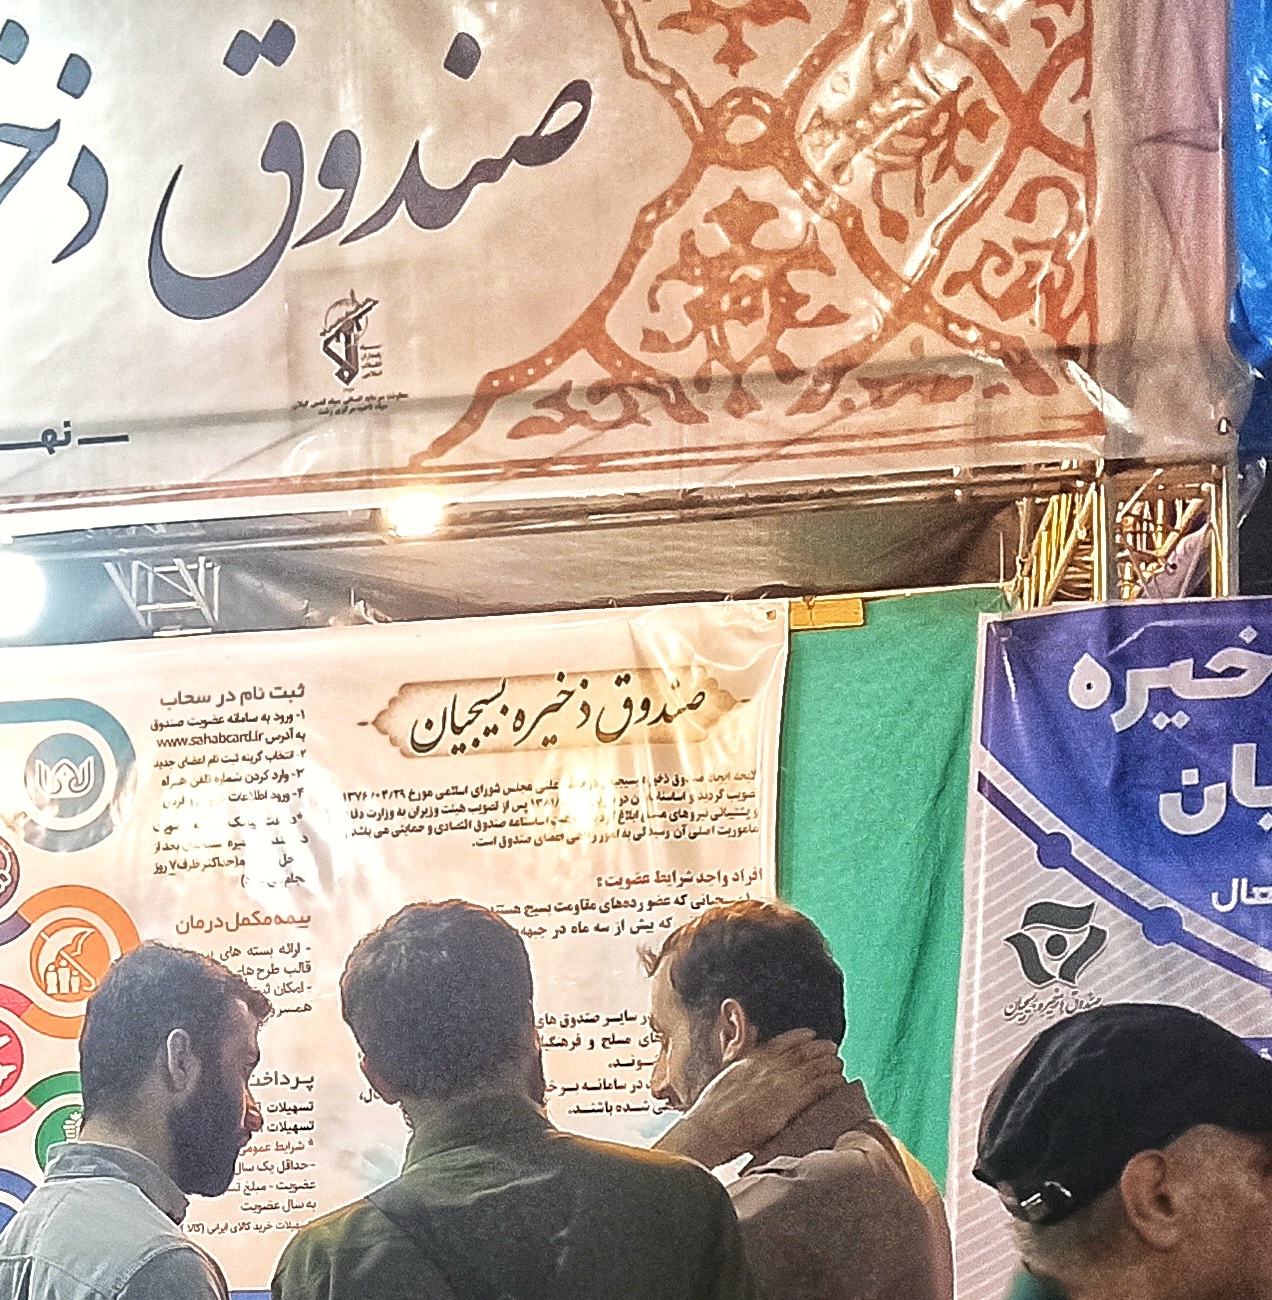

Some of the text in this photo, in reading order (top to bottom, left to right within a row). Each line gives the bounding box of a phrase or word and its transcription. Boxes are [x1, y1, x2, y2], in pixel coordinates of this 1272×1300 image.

[146, 19, 592, 319] صندوق
[160, 683, 305, 711] ثبت نام در سحاب
[410, 671, 706, 756] صندوق ذخیره بسیجیان
[151, 712, 293, 731] ورود به سامانه عضویت صندوق
[265, 727, 294, 744] آدرس
[296, 732, 306, 742] به
[221, 754, 239, 765] ثبت
[242, 750, 263, 764] گزینه
[265, 750, 294, 763] انتخاب
[245, 770, 269, 784] کردن
[272, 769, 289, 782] وارد
[471, 783, 500, 798] شورای
[503, 782, 533, 796] مجلس
[367, 809, 394, 821] وزارت
[397, 808, 406, 818] به
[408, 806, 438, 820] وزیران
[604, 873, 649, 890] عضویت
[654, 869, 693, 888] شرایط
[732, 867, 763, 887] افراد
[524, 894, 688, 918] که عضو مقاومت بسیج
[176, 910, 311, 934] بیمه مکمل درمان
[593, 924, 610, 933] سه
[614, 919, 626, 936] از
[630, 918, 654, 935] بیش
[659, 916, 673, 929] که
[220, 945, 241, 961] های
[247, 947, 273, 958] بسته
[257, 960, 311, 980] قالب طرح
[274, 981, 304, 996] امکان
[277, 1002, 312, 1017] همسر
[536, 1009, 637, 1029] سایر صندوق های
[587, 1033, 631, 1050] مسلح و
[582, 1078, 643, 1093] در سامانه
[267, 1101, 314, 1115] تسهیلات
[616, 1100, 650, 1112] شده
[267, 1120, 314, 1134] تسهیلات
[274, 1141, 305, 1154] شرایط
[235, 1161, 274, 1175] یک سال
[243, 1181, 266, 1195] مبلغ
[276, 1180, 316, 1193] عضویت
[241, 1199, 316, 1213] به سال عضویت
[253, 1222, 273, 1233] خرید
